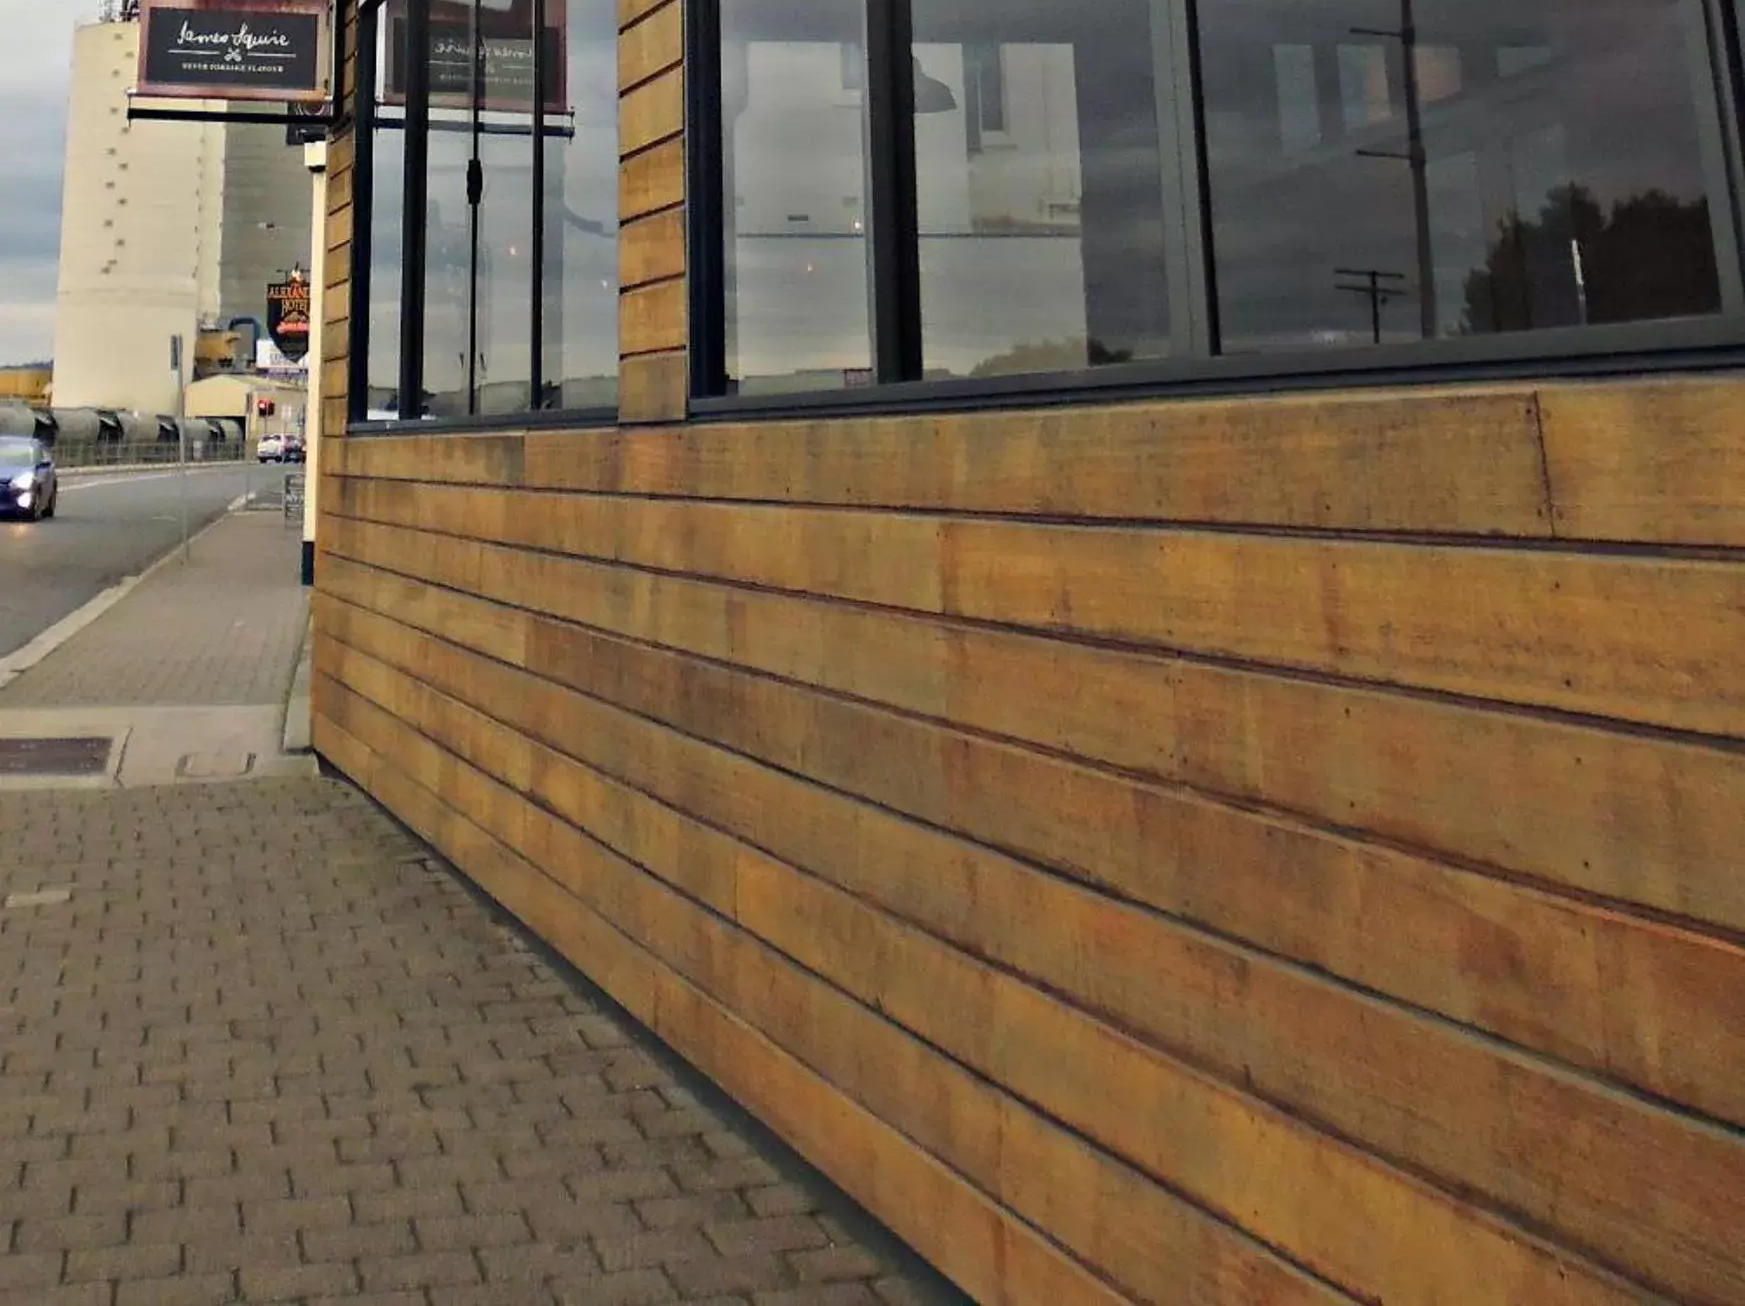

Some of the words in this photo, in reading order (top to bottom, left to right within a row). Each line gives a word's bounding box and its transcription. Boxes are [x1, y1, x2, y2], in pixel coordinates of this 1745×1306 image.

[177, 20, 229, 45] James
[231, 21, 289, 50] Squire
[281, 299, 308, 316] HOTEL
